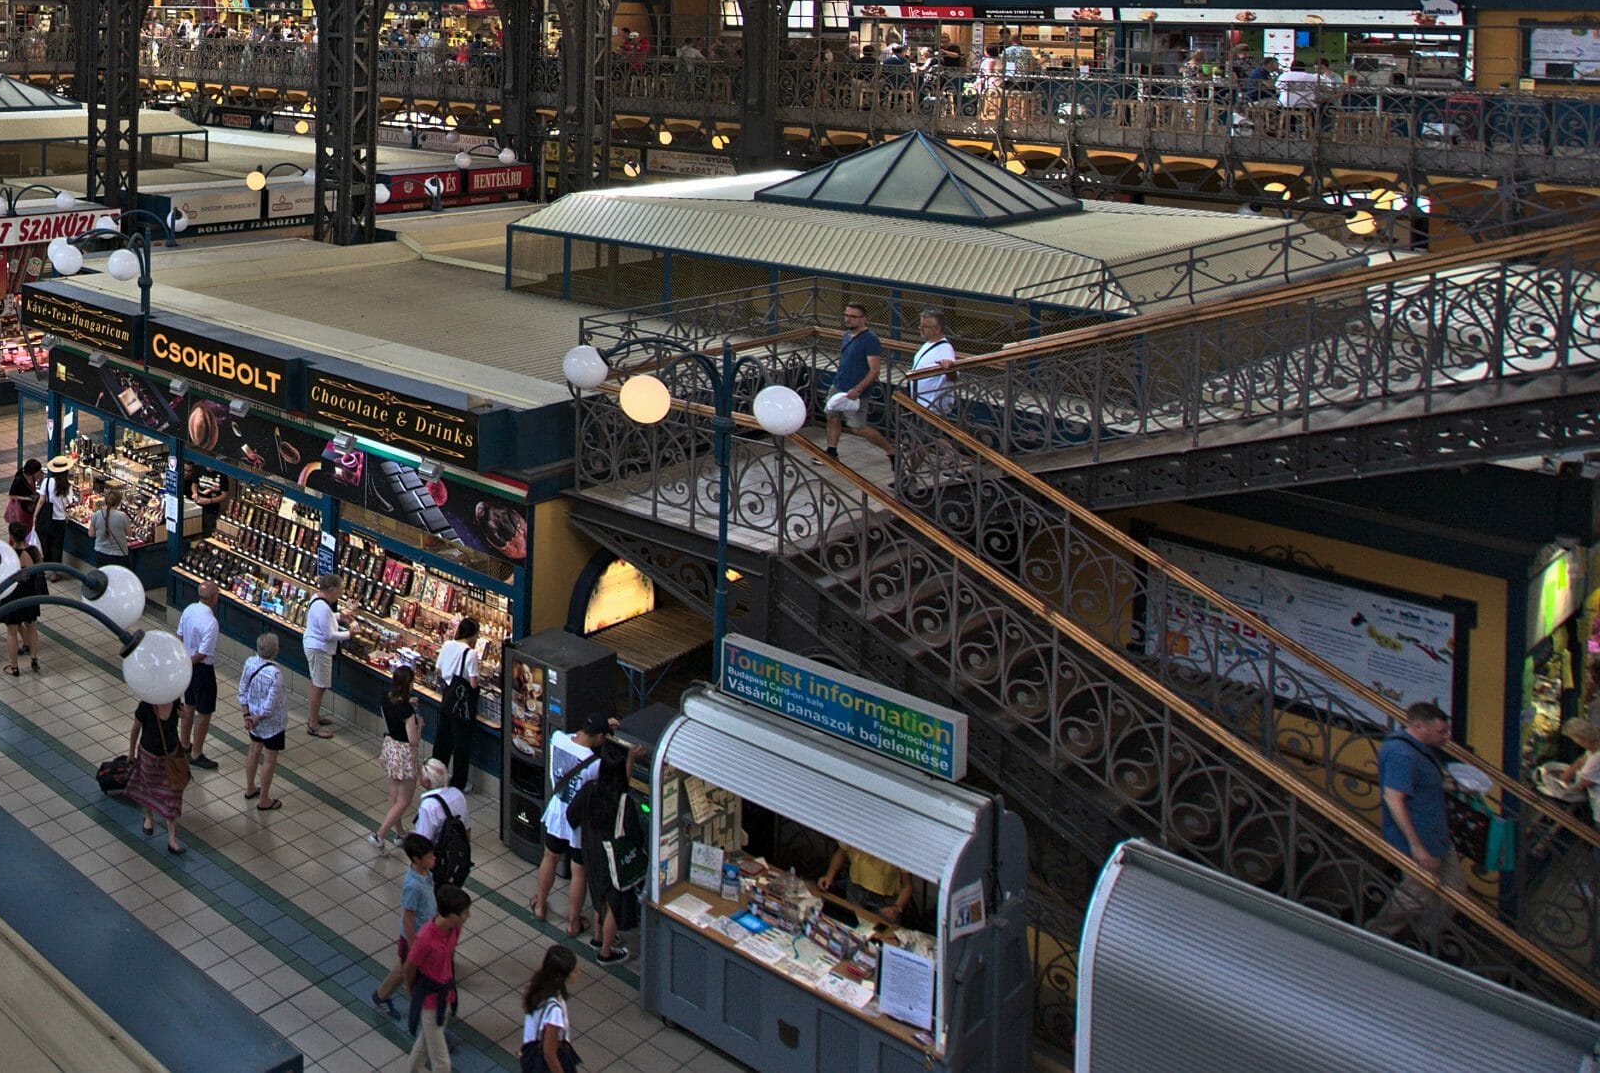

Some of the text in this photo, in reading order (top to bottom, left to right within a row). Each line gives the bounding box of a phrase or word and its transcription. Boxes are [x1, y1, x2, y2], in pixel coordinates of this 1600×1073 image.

[446, 174, 456, 191] ÉS
[473, 169, 522, 189] HENTESÁRU
[311, 385, 389, 422] Chocolate
[396, 411, 408, 427] &
[415, 416, 474, 448] Drinks
[726, 646, 950, 745] Tourist information
[727, 666, 768, 687] Budapest
[806, 696, 825, 709] sale
[728, 676, 949, 772] Vásárlói panaszok bejelentése
[873, 721, 949, 756] Free brochures
